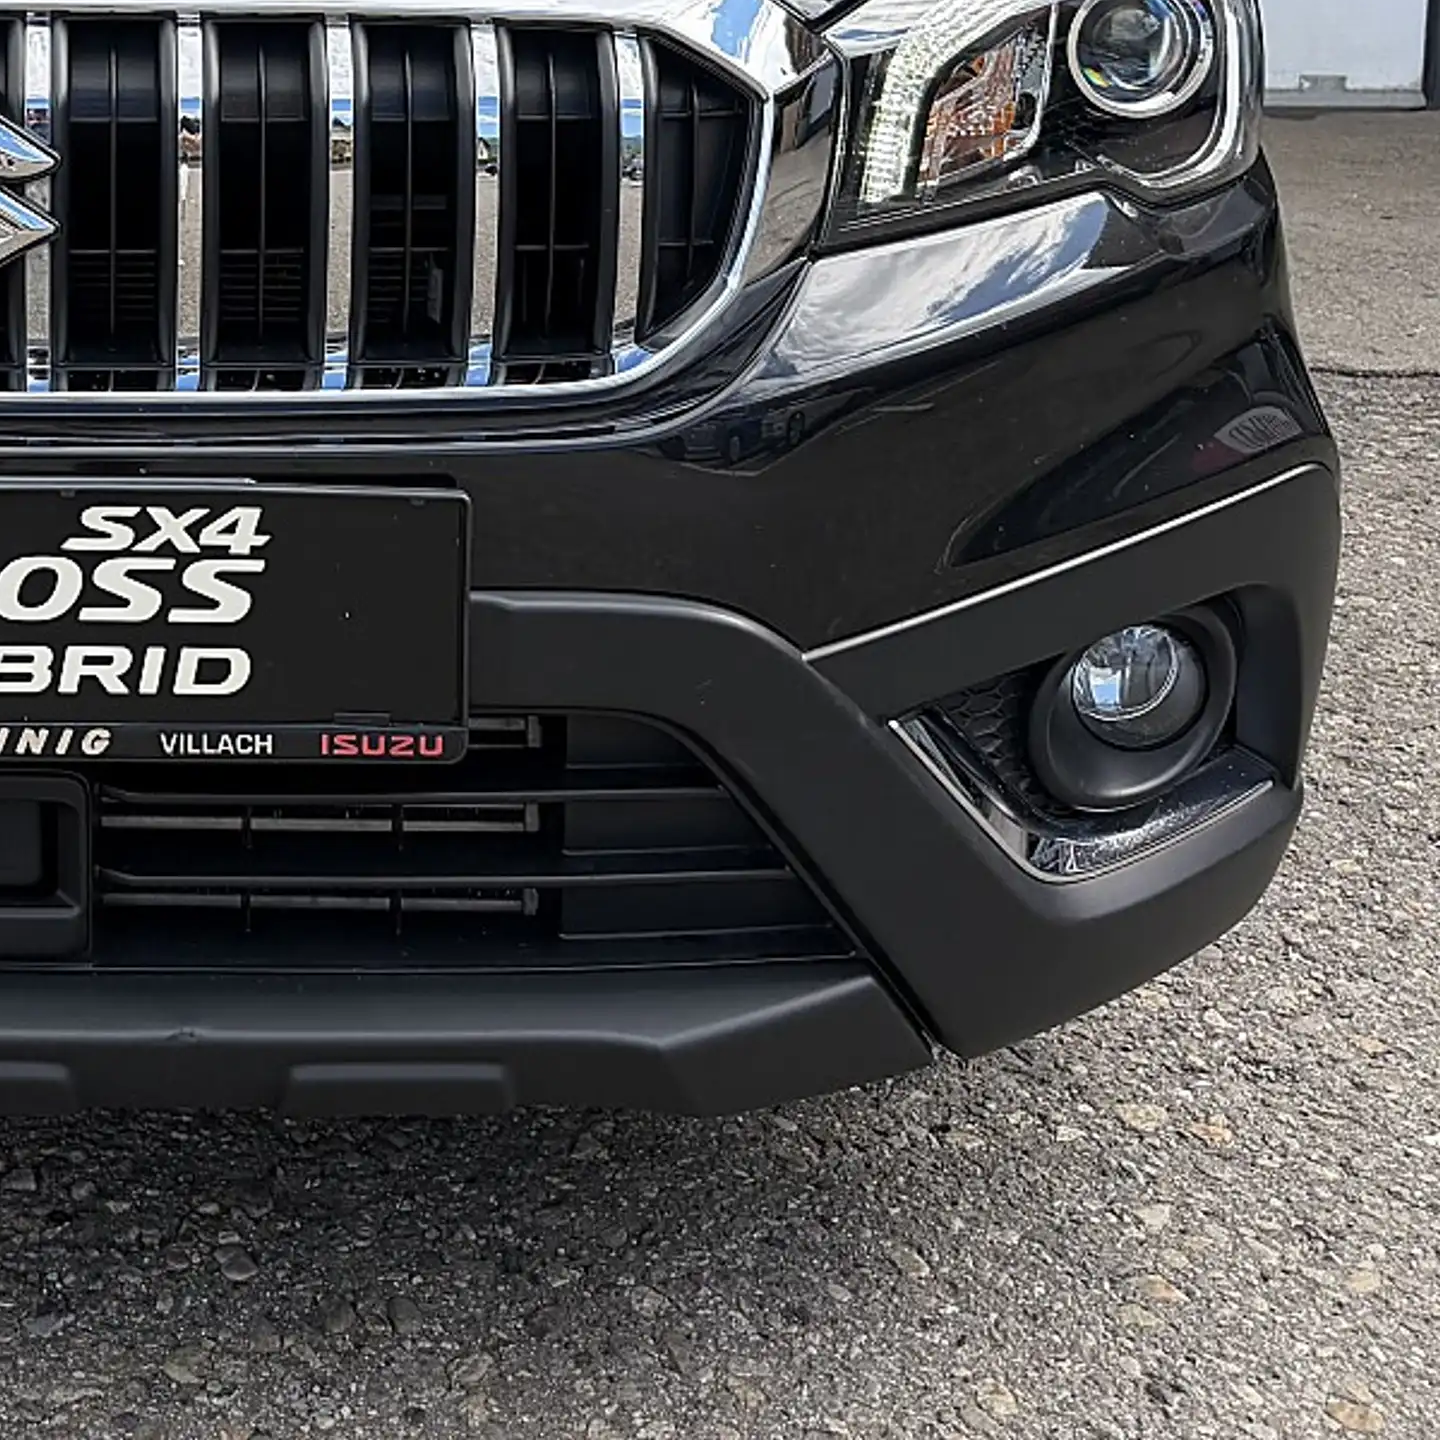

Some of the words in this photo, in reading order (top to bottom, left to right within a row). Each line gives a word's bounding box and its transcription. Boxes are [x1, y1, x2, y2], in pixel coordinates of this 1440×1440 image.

[60, 506, 272, 554] SX4
[160, 732, 274, 756] VILLACH
[321, 733, 445, 757] ISUZU
